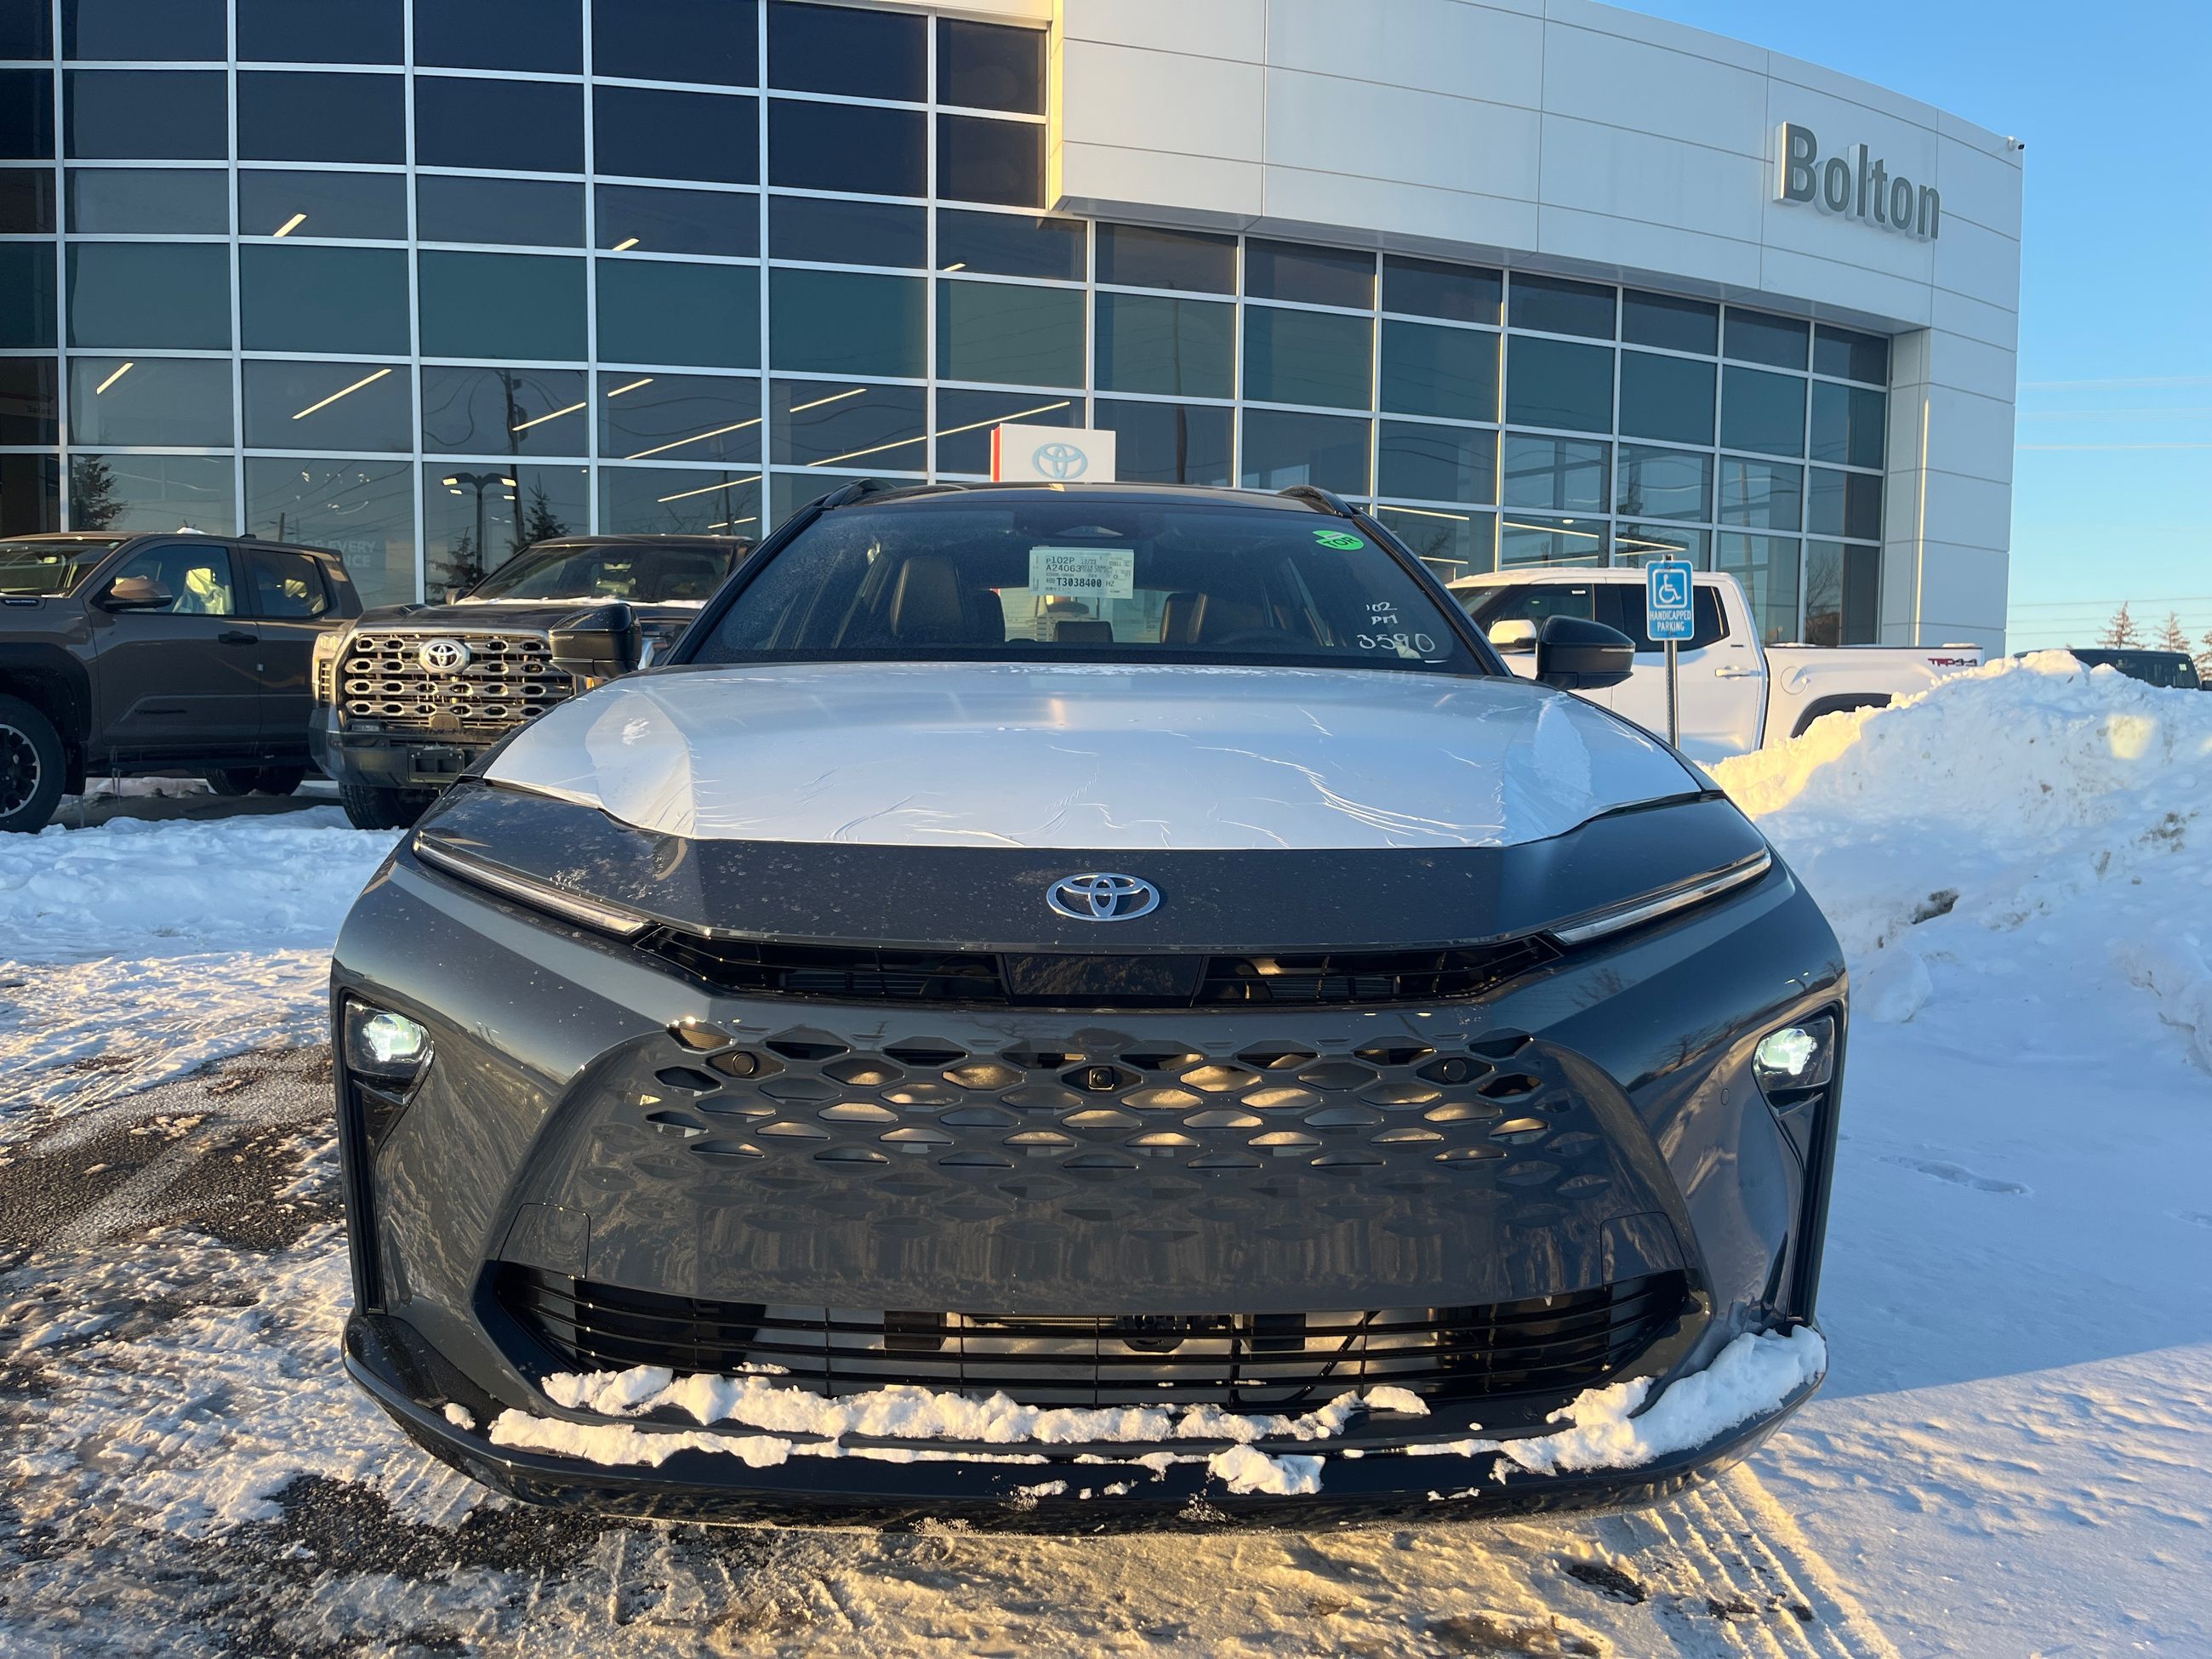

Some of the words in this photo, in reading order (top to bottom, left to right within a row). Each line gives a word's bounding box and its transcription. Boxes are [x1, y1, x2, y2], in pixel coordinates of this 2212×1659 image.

[1774, 121, 1941, 241] Bolton
[1323, 536, 1360, 547] TOR
[1046, 564, 1082, 573] A24063
[1057, 577, 1102, 588] T3038400
[1650, 610, 1691, 621] HANDICAPPED
[1657, 621, 1685, 632] PARKING
